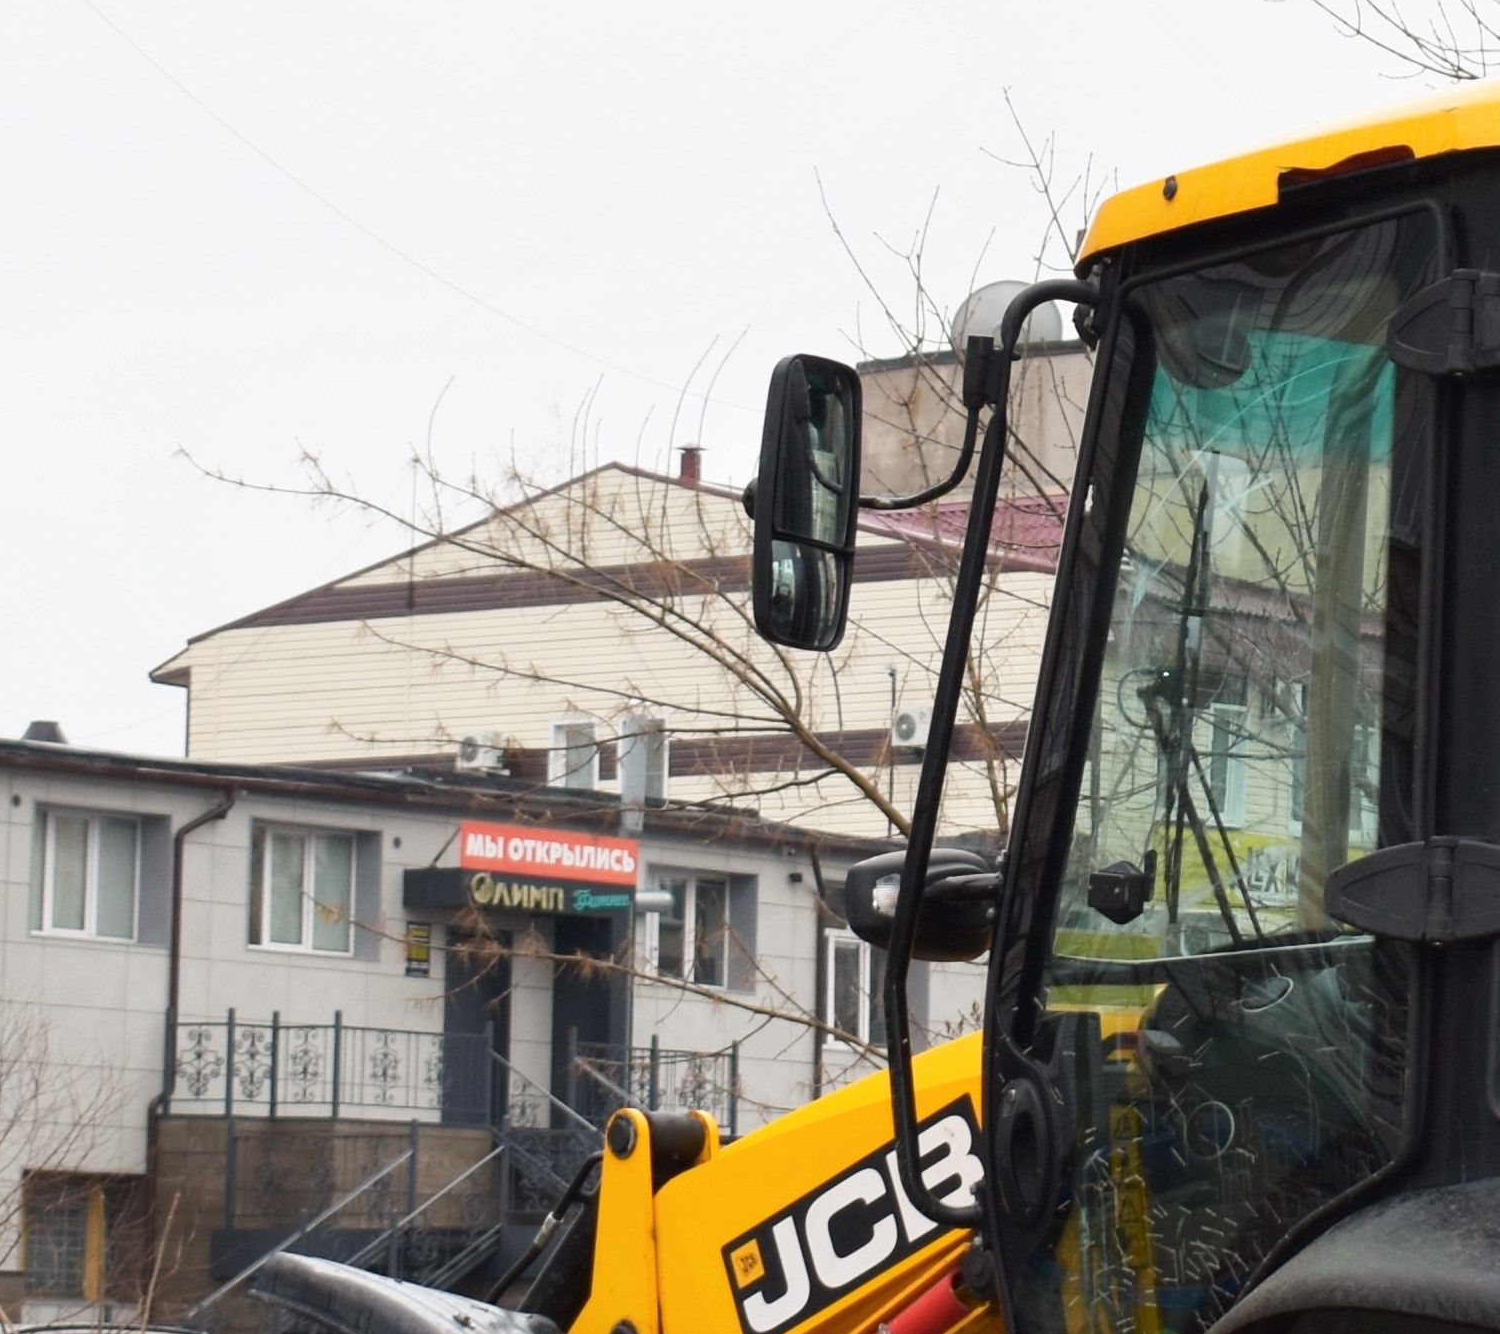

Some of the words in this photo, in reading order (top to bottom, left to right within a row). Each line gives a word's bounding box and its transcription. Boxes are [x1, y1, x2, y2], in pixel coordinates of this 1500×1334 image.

[466, 833, 504, 859] МЫ
[508, 837, 635, 873] ОТКРЫЛИСЬ
[743, 1114, 985, 1334] JCB
